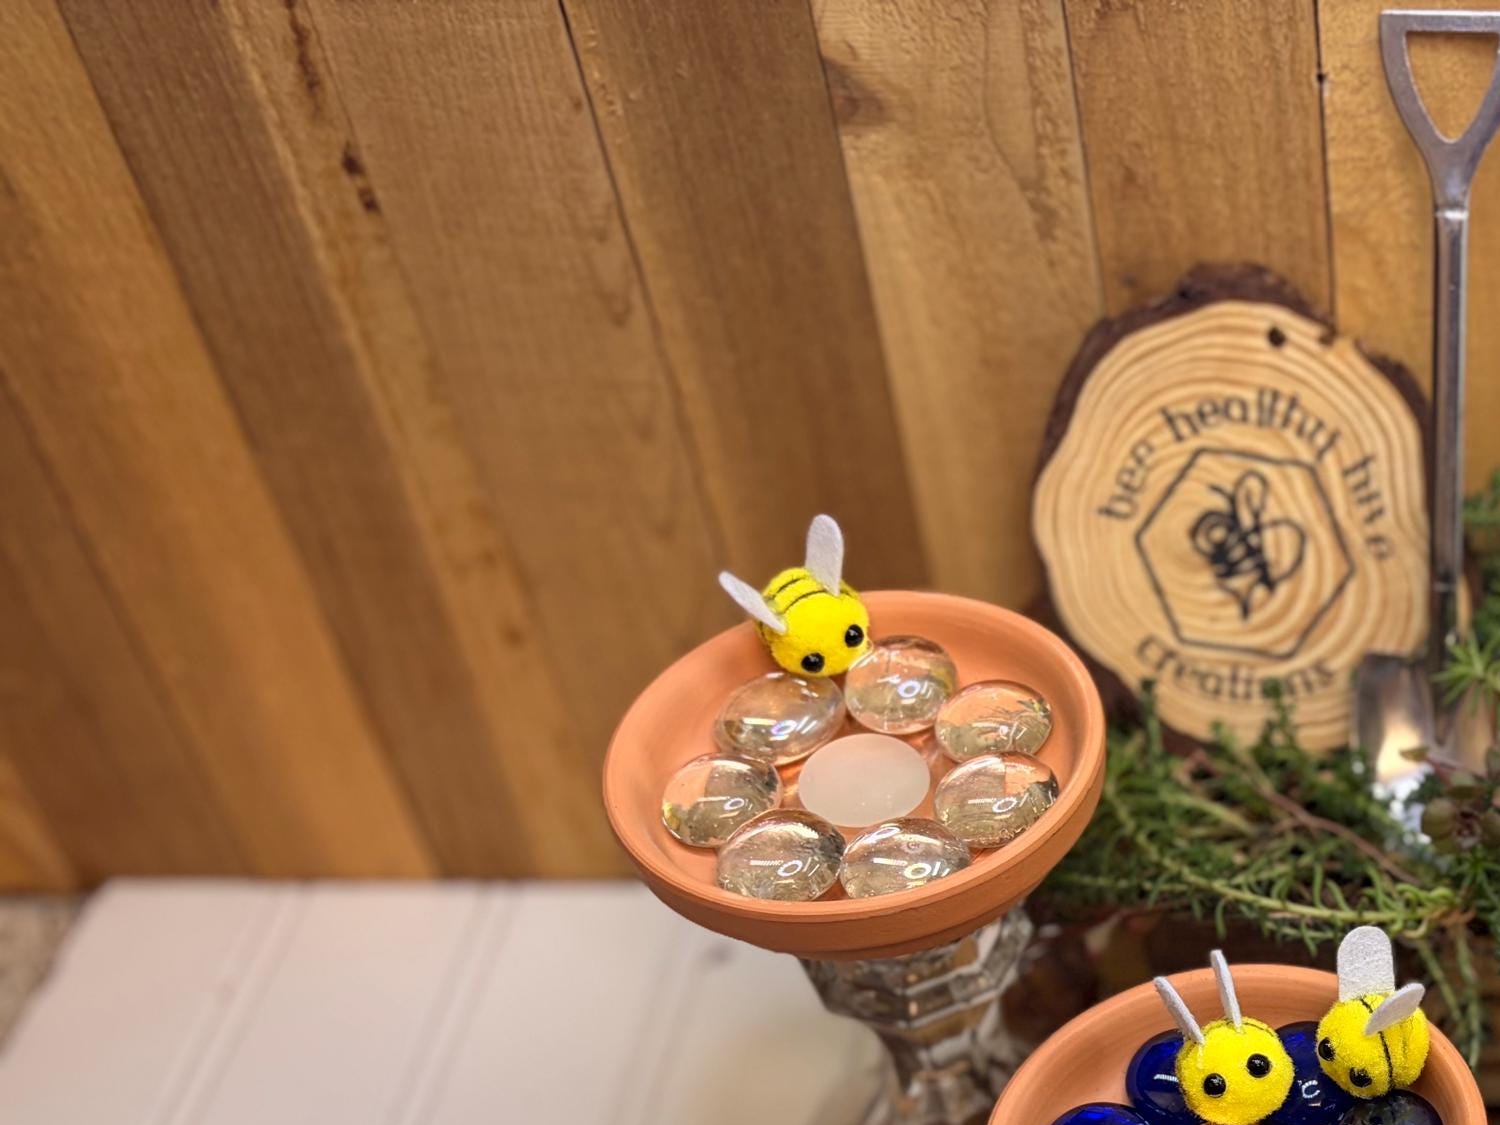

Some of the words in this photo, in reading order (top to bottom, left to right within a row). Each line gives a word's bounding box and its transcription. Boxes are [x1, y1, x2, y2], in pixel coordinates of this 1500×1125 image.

[1097, 438, 1154, 521] bee
[1160, 387, 1342, 462] healthy
[1343, 453, 1394, 561] hive
[1135, 634, 1335, 700] creatins
